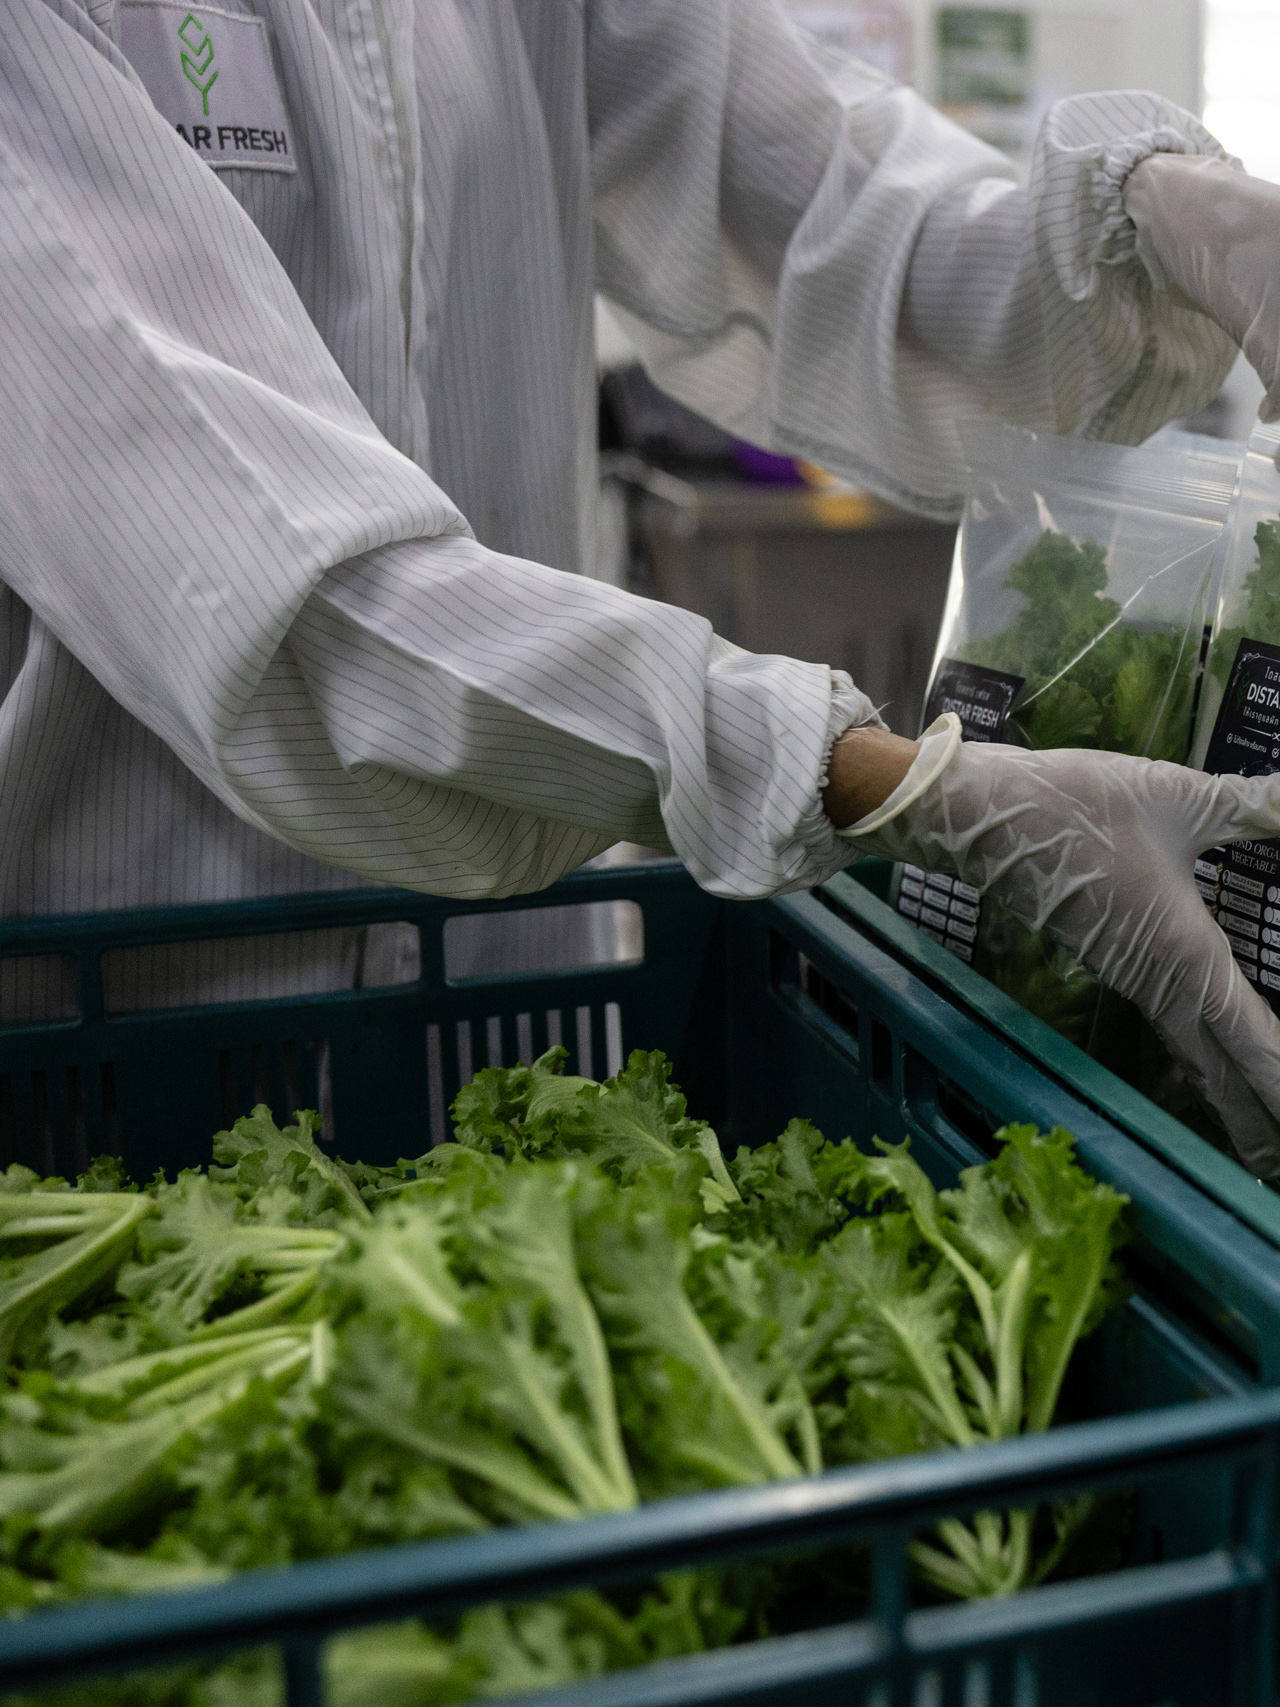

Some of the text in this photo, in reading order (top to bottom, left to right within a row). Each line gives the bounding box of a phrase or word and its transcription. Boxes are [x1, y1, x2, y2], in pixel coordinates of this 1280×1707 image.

[217, 126, 288, 154] FRESH
[970, 705, 1000, 729] FRESH
[1231, 849, 1277, 875] VEGETABLE
